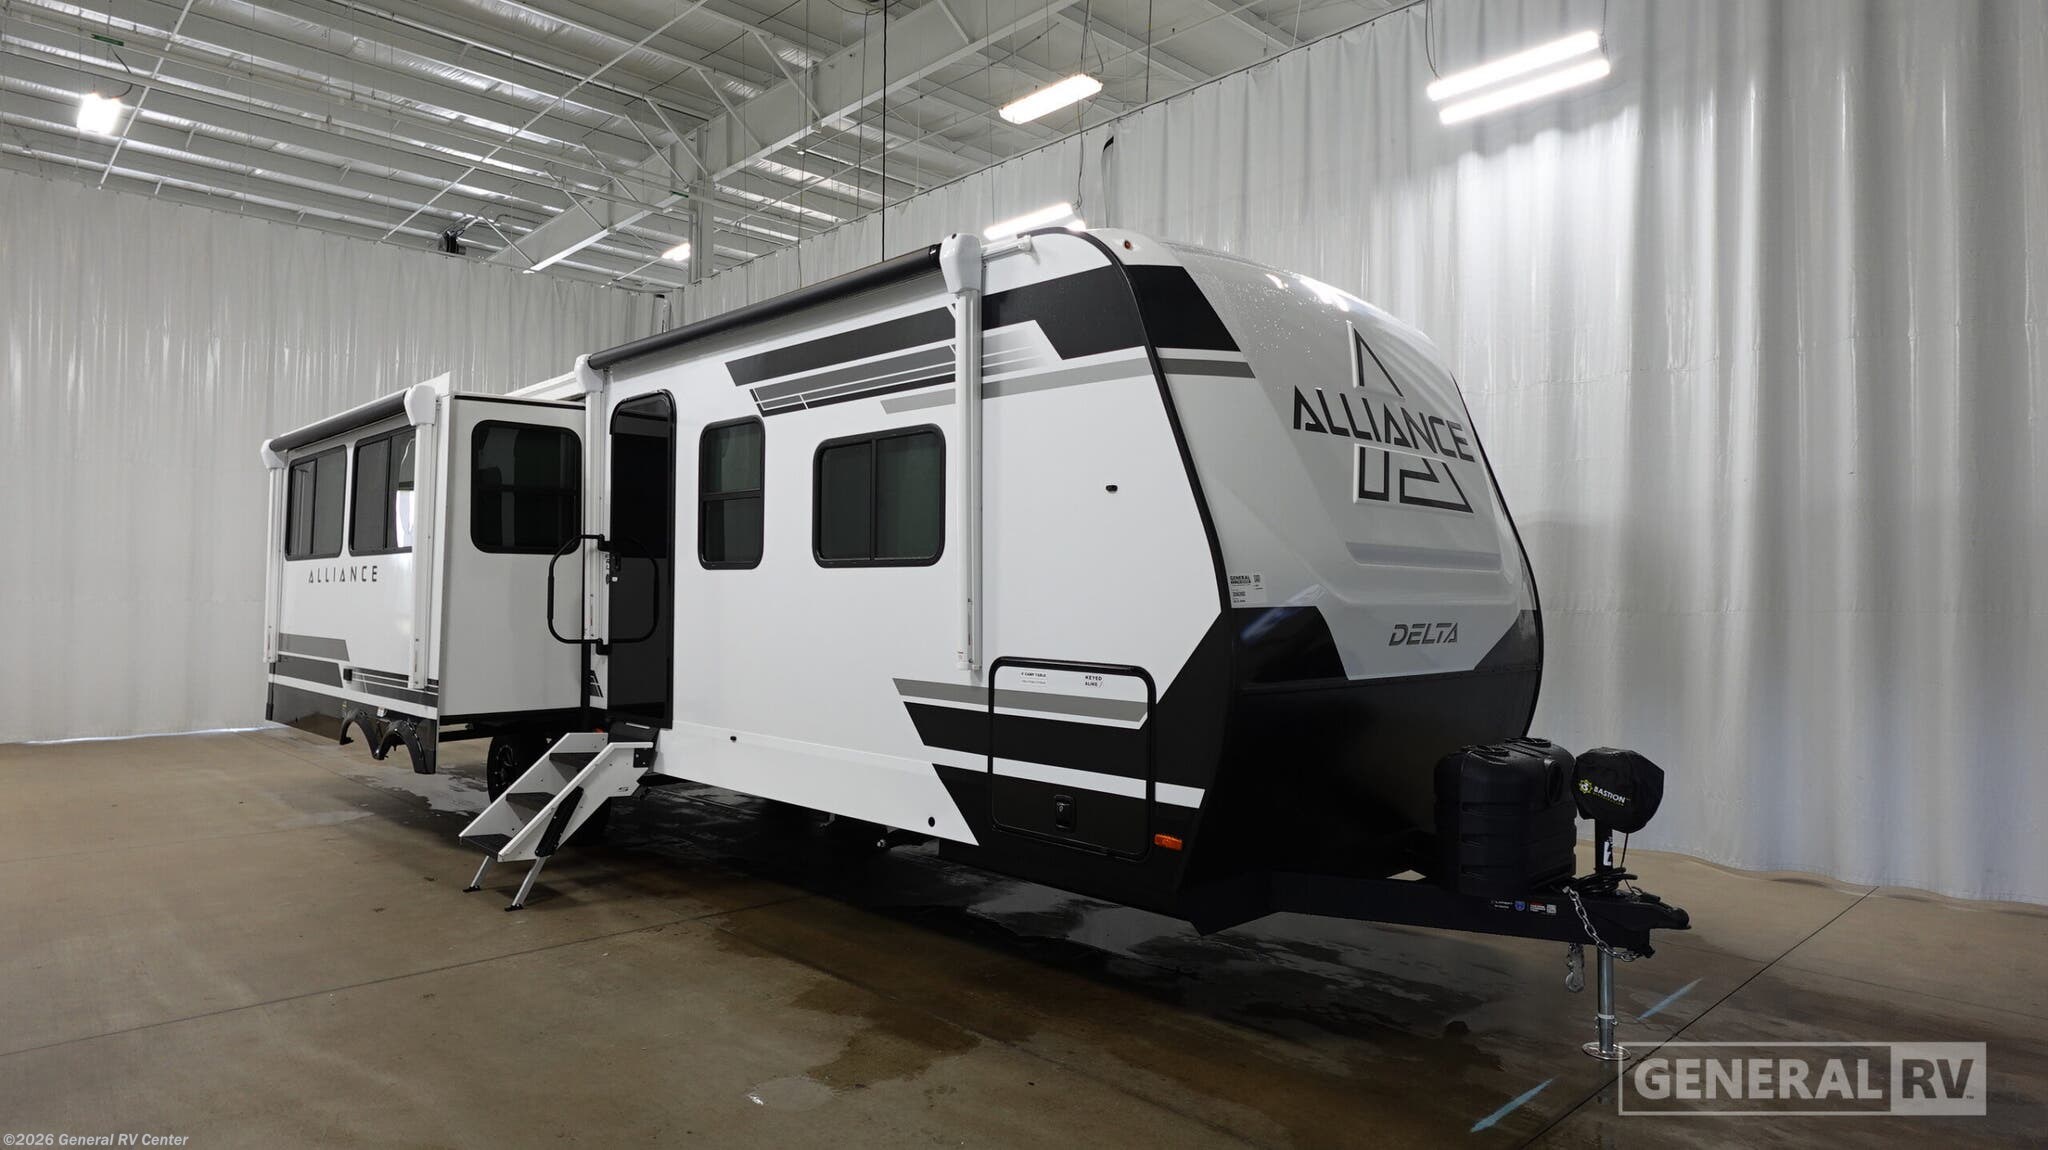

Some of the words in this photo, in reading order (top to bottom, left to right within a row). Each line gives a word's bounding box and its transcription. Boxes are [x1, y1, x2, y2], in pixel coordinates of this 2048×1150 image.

[1293, 385, 1476, 463] ALLIANCE
[308, 565, 378, 584] ALLIANCE
[1388, 622, 1458, 646] DELTA
[1593, 786, 1626, 803] BASTION
